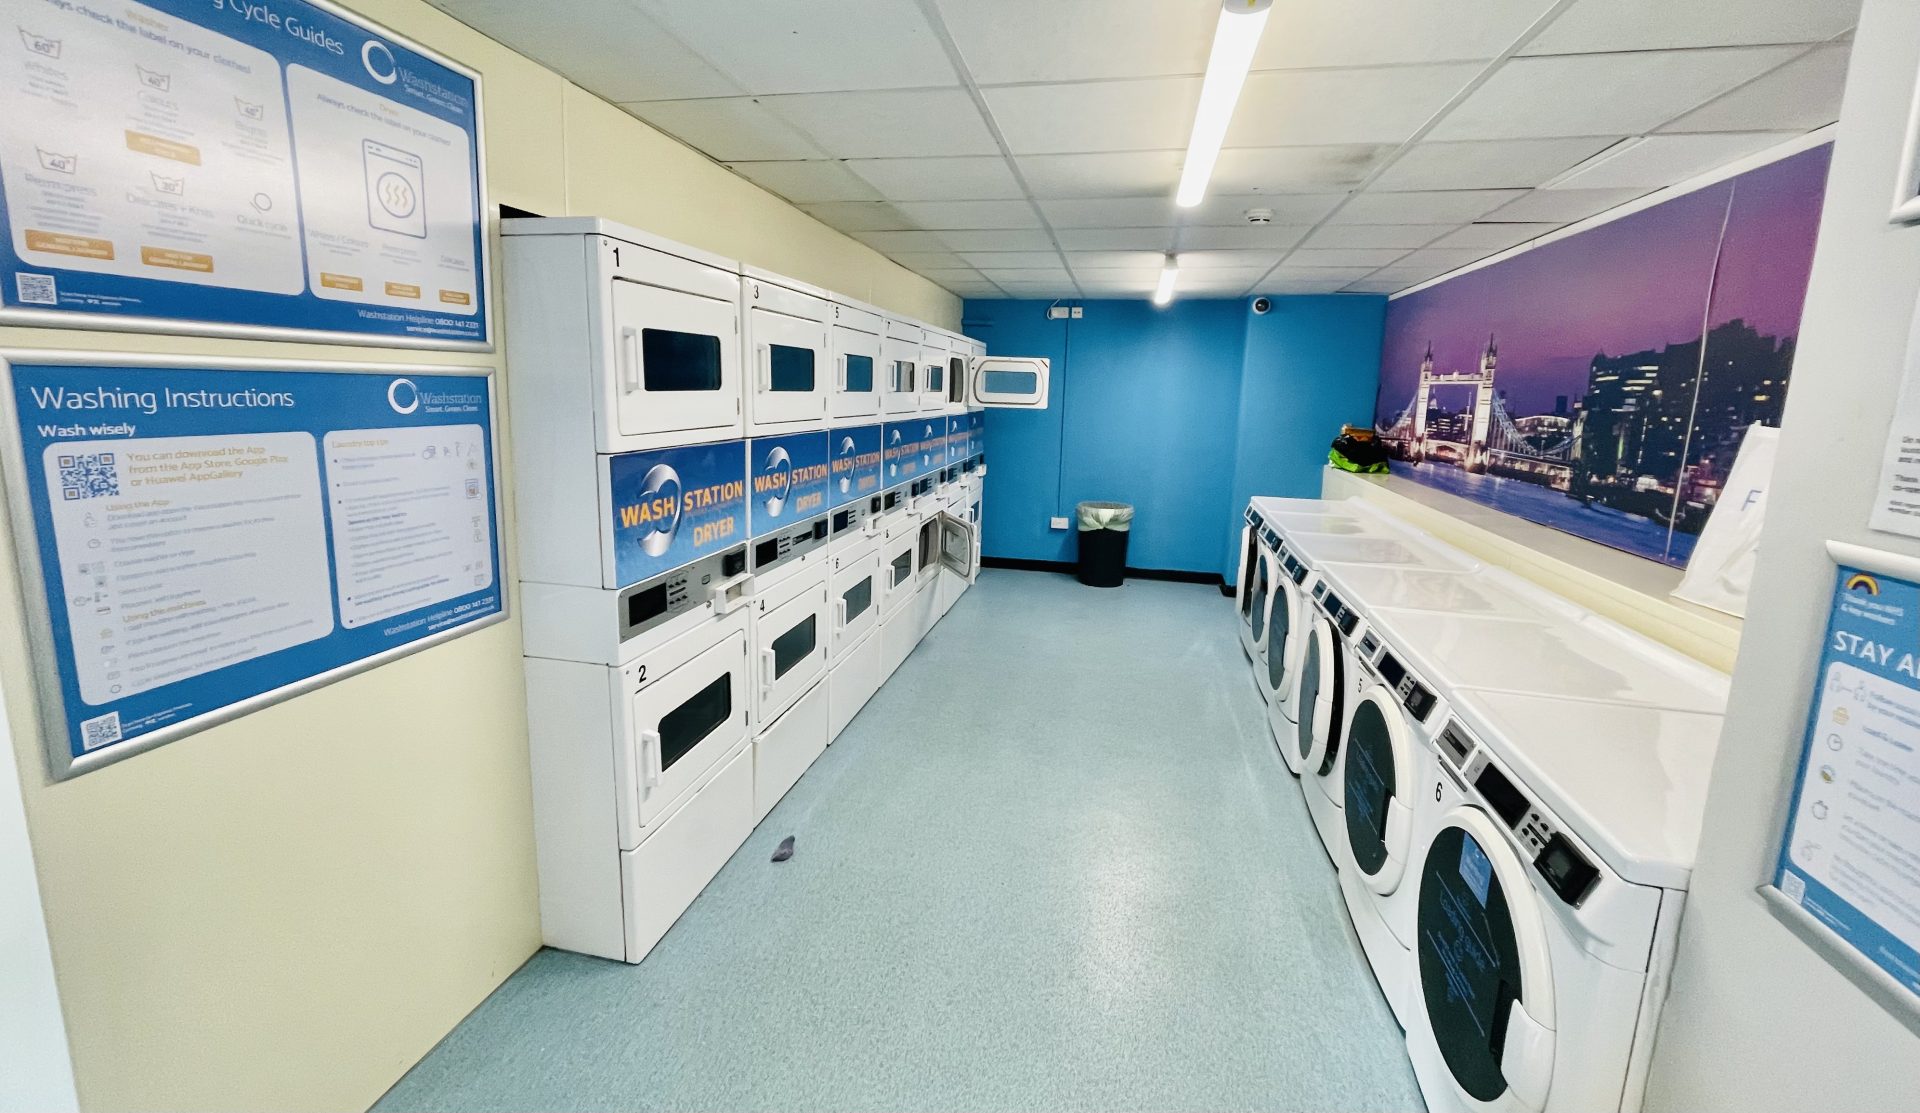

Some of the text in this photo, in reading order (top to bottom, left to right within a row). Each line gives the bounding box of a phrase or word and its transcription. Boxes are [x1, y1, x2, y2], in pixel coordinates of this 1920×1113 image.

[116, 18, 136, 34] the
[230, 0, 344, 56] Cycle Guides
[613, 247, 620, 267] 1
[753, 284, 760, 300] 3
[357, 308, 405, 321] Washstation
[405, 314, 435, 325] Helpline
[834, 306, 840, 320] 5
[30, 386, 295, 415] Washing Instructions
[418, 391, 483, 406] Washstation
[37, 423, 137, 438] Wash wisely
[126, 452, 150, 462] You
[152, 452, 173, 461] can
[228, 446, 246, 456] the
[832, 451, 881, 473] WASH STATION
[129, 464, 158, 474] from
[159, 463, 178, 472] the
[180, 462, 203, 471] App
[130, 478, 143, 487] or
[145, 473, 187, 486] Huawei
[754, 464, 828, 494] WASH STATION
[620, 479, 744, 530] WASH STATION
[796, 491, 823, 514] DRYER
[693, 516, 735, 548] DRYER
[835, 557, 840, 569] 6
[759, 599, 765, 612] 4
[1833, 630, 1895, 666] STAY
[638, 664, 647, 683] 2
[1434, 781, 1443, 802] 6
